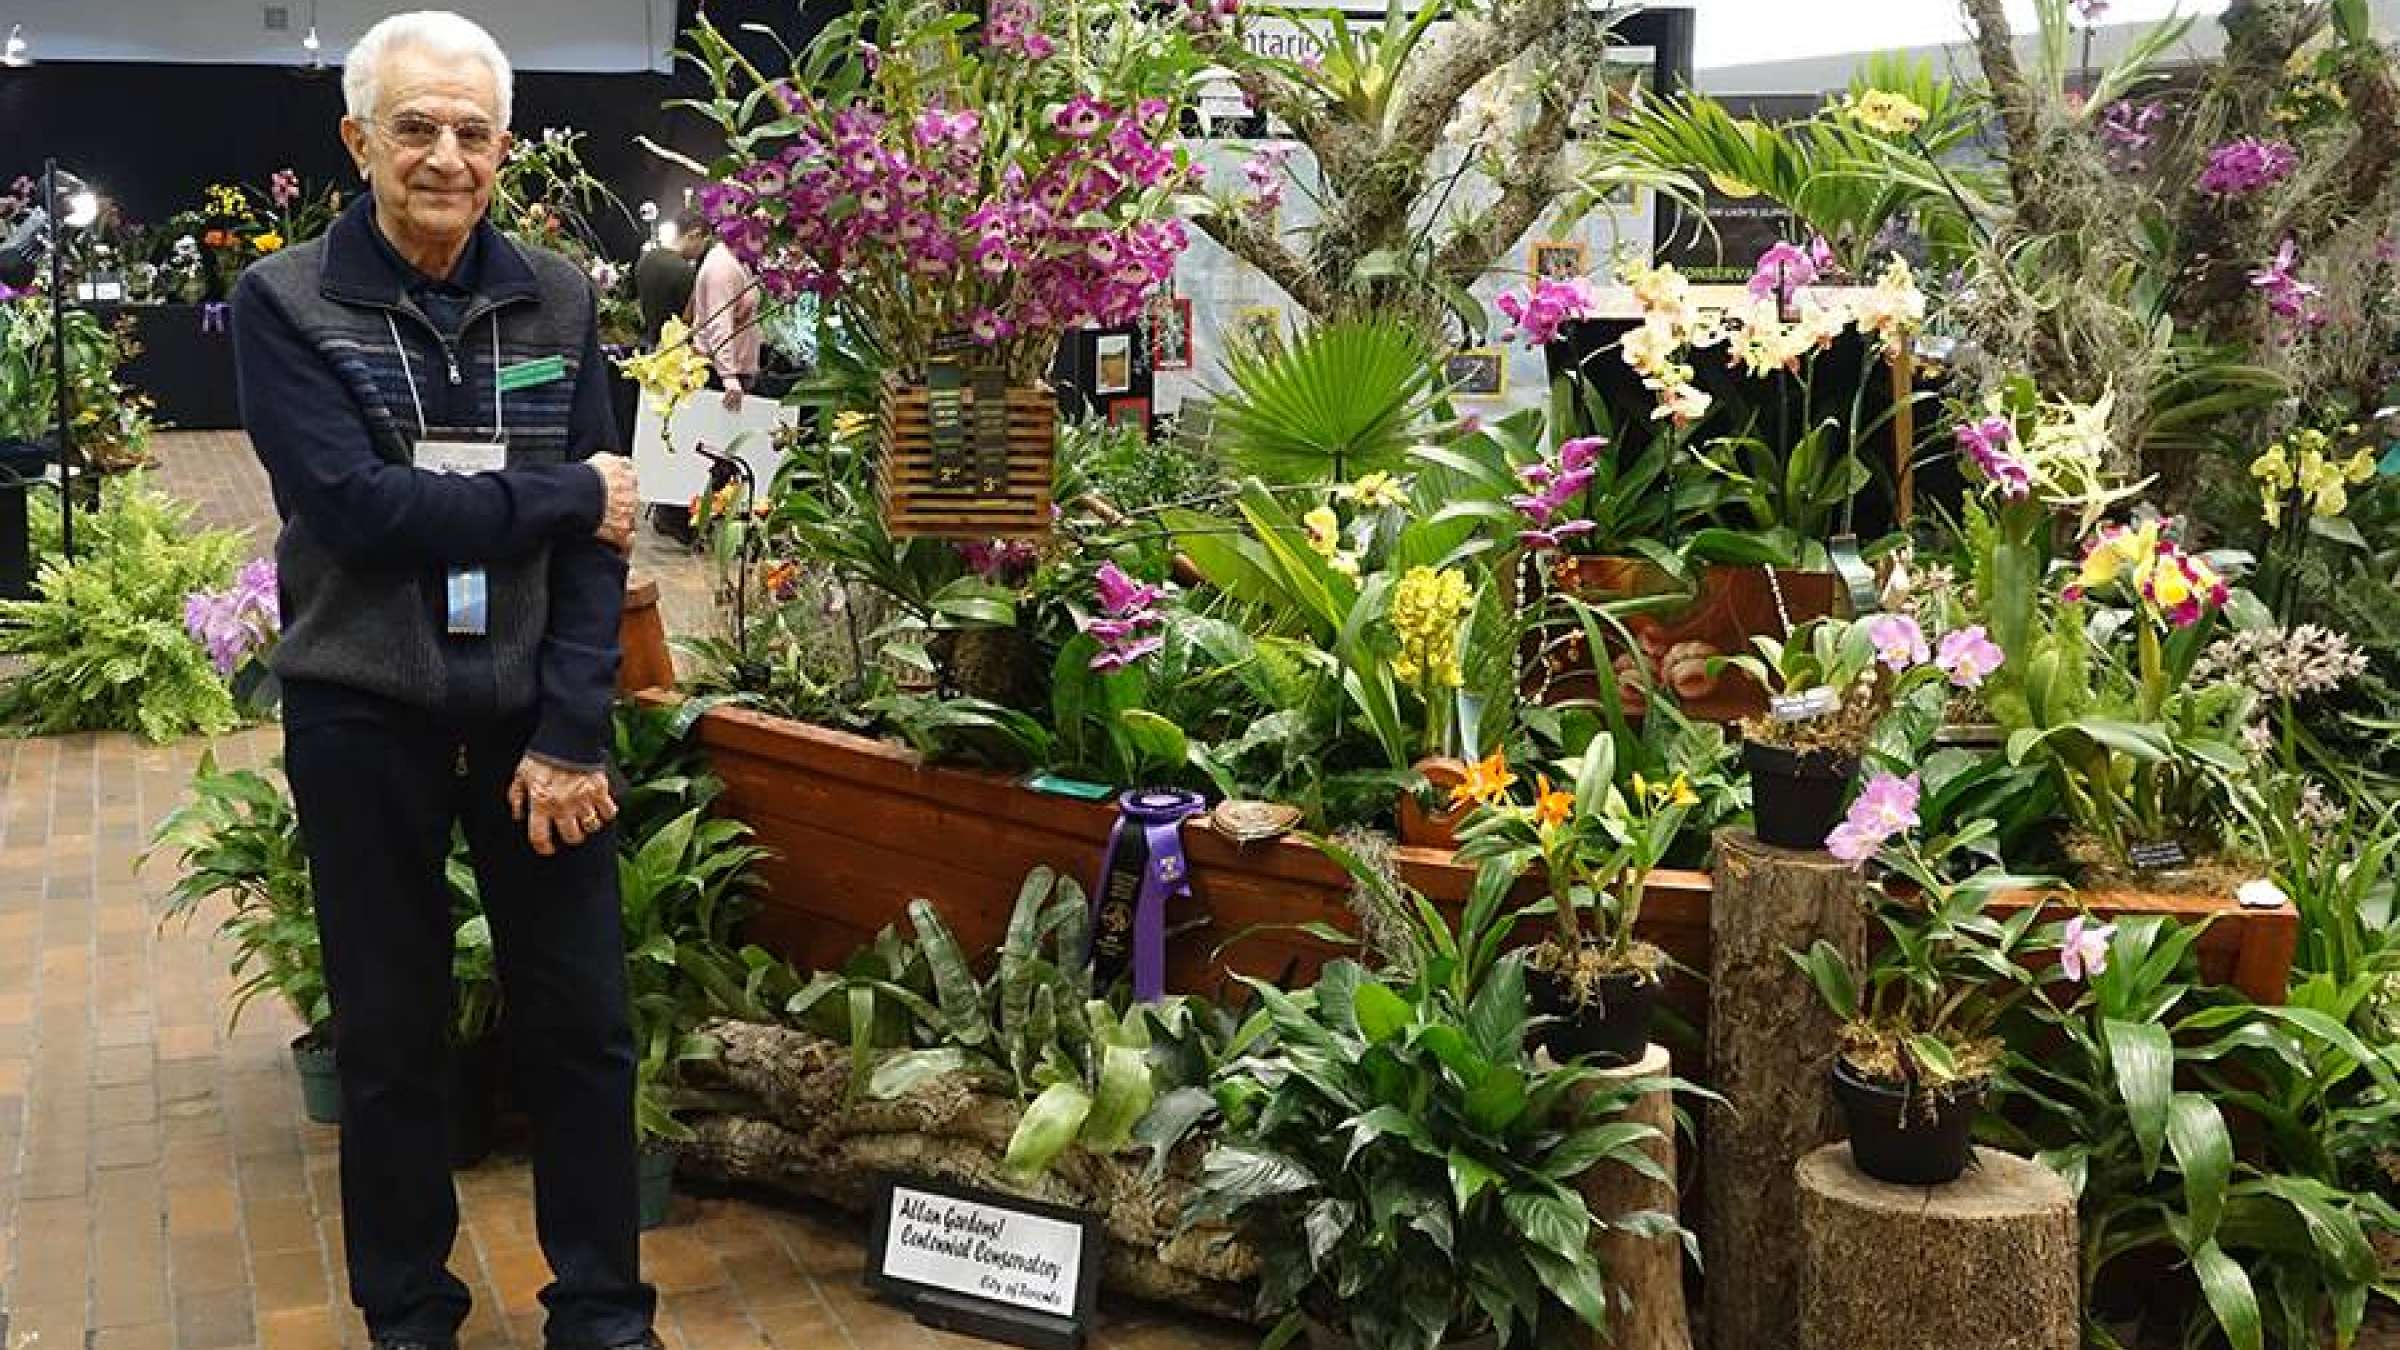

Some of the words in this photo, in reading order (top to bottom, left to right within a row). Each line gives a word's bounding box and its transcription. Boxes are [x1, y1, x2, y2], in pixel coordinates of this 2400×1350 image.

[899, 1197, 942, 1225] Allan
[901, 1223, 974, 1260] Centennial
[973, 1240, 1063, 1284] Conservatory
[980, 1274, 1001, 1294] City
